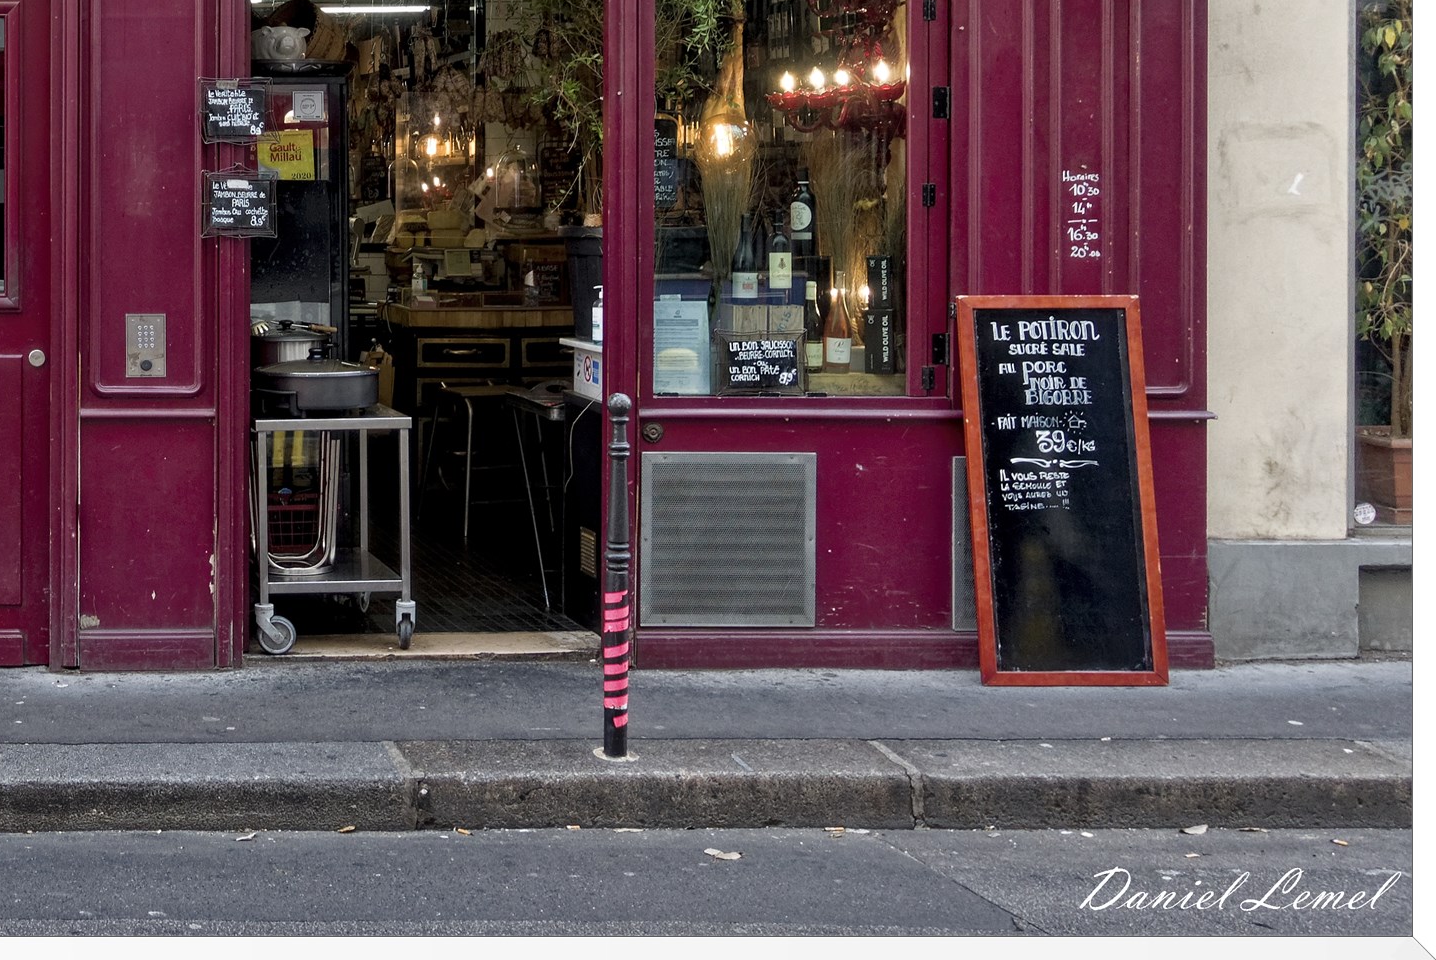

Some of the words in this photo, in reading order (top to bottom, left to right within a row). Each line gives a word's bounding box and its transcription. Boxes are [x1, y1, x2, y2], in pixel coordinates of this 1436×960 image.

[269, 143, 296, 152] Gault
[270, 152, 302, 162] Millau
[291, 172, 311, 180] 2020
[1062, 170, 1099, 182] Horaires
[990, 321, 1011, 341] LE
[1018, 316, 1100, 341] POTIRON
[1070, 377, 1087, 389] DE
[1025, 390, 1092, 405] BIGORRE
[999, 469, 1009, 482] IL
[1011, 472, 1037, 481] VOUS
[1000, 483, 1010, 491] LA
[1056, 480, 1066, 488] ET
